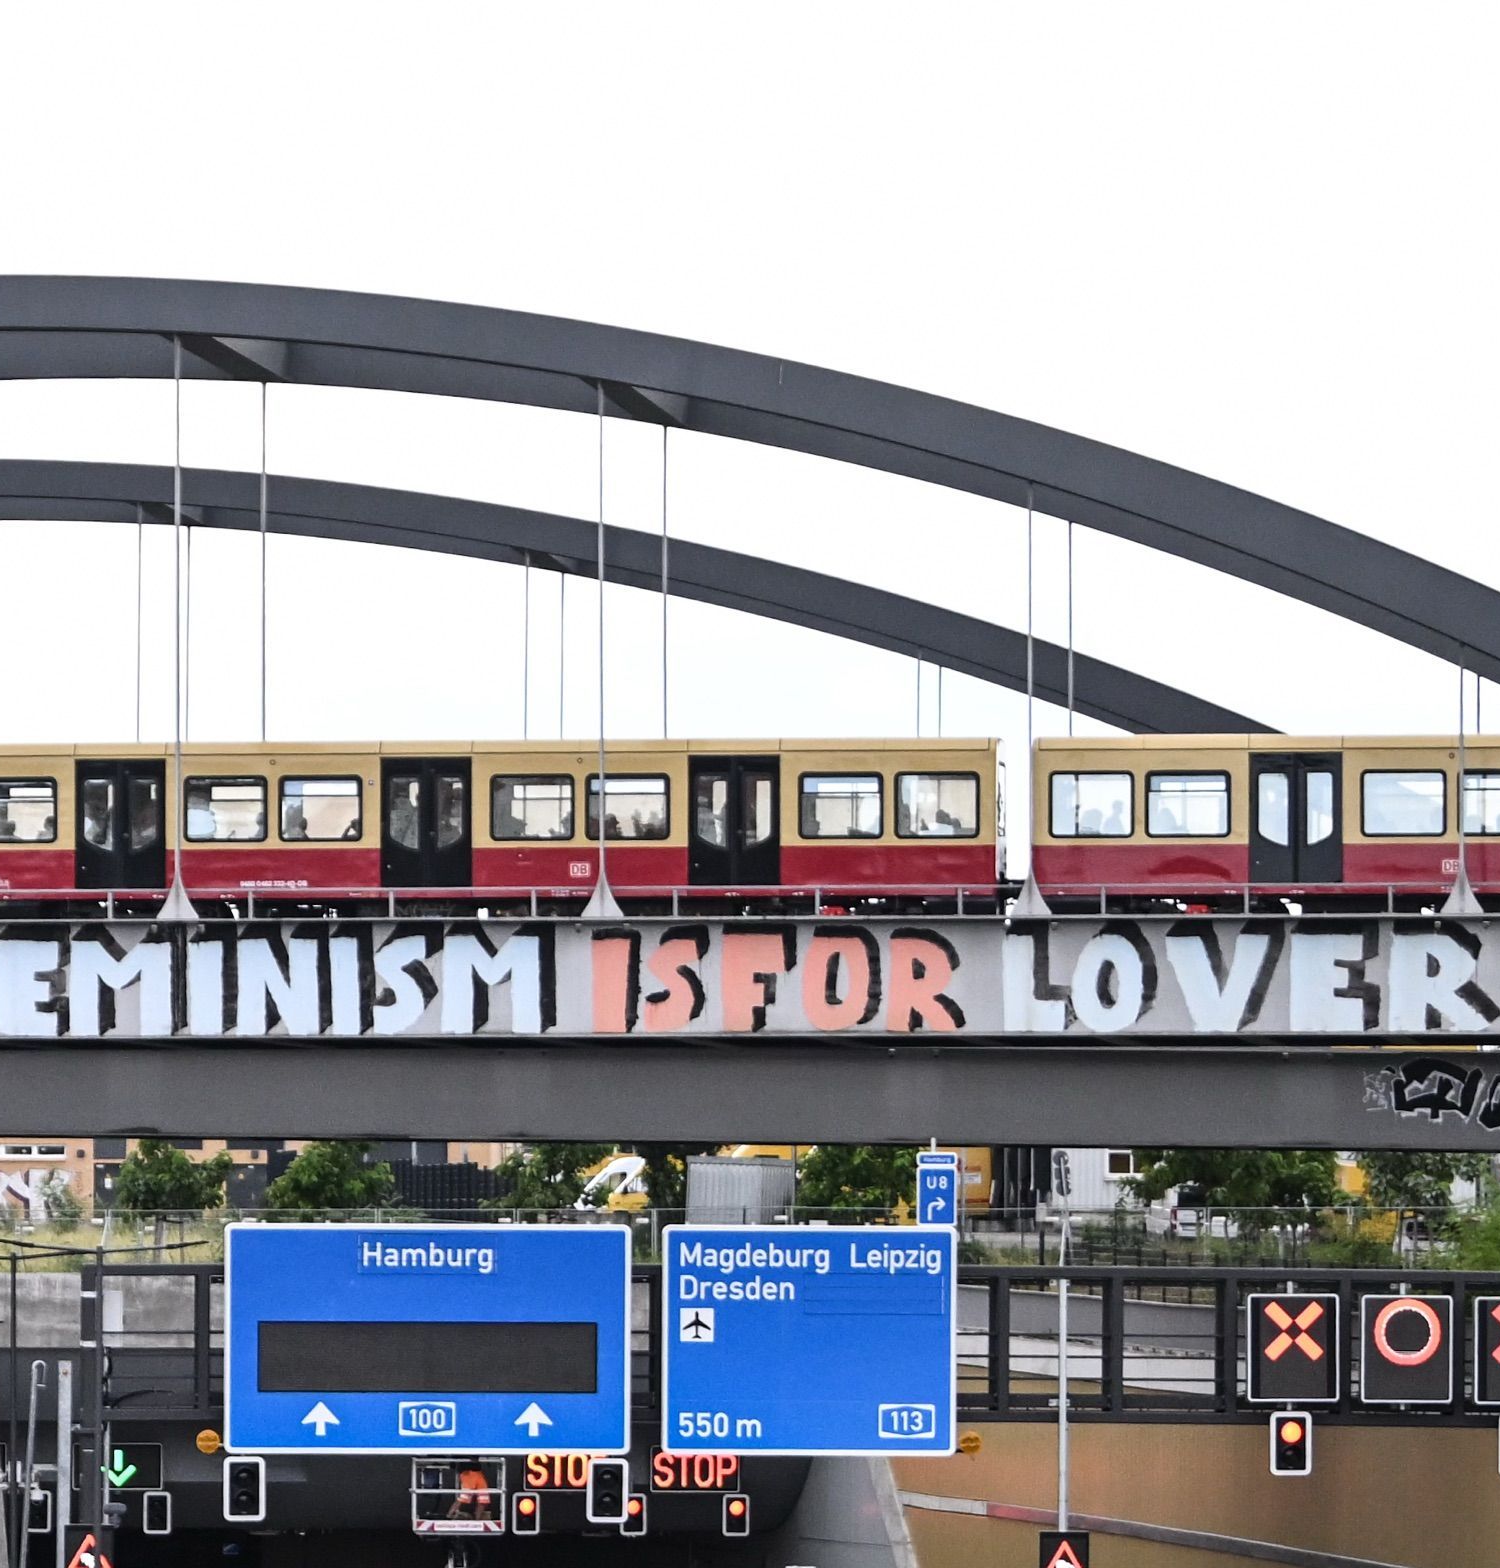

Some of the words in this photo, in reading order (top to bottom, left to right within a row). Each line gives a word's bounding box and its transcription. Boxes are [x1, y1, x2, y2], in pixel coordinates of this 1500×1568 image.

[570, 863, 589, 876] DB
[926, 1175, 948, 1190] U8
[362, 1242, 493, 1273] Hamburg
[680, 1242, 830, 1274] Magdeburg
[849, 1242, 942, 1274] Leipzig
[680, 1275, 796, 1300] Dresden
[408, 1407, 446, 1431] 100
[678, 1412, 731, 1438] 550
[735, 1418, 762, 1437] m
[888, 1410, 924, 1433] 113
[653, 1453, 738, 1488] STOP
